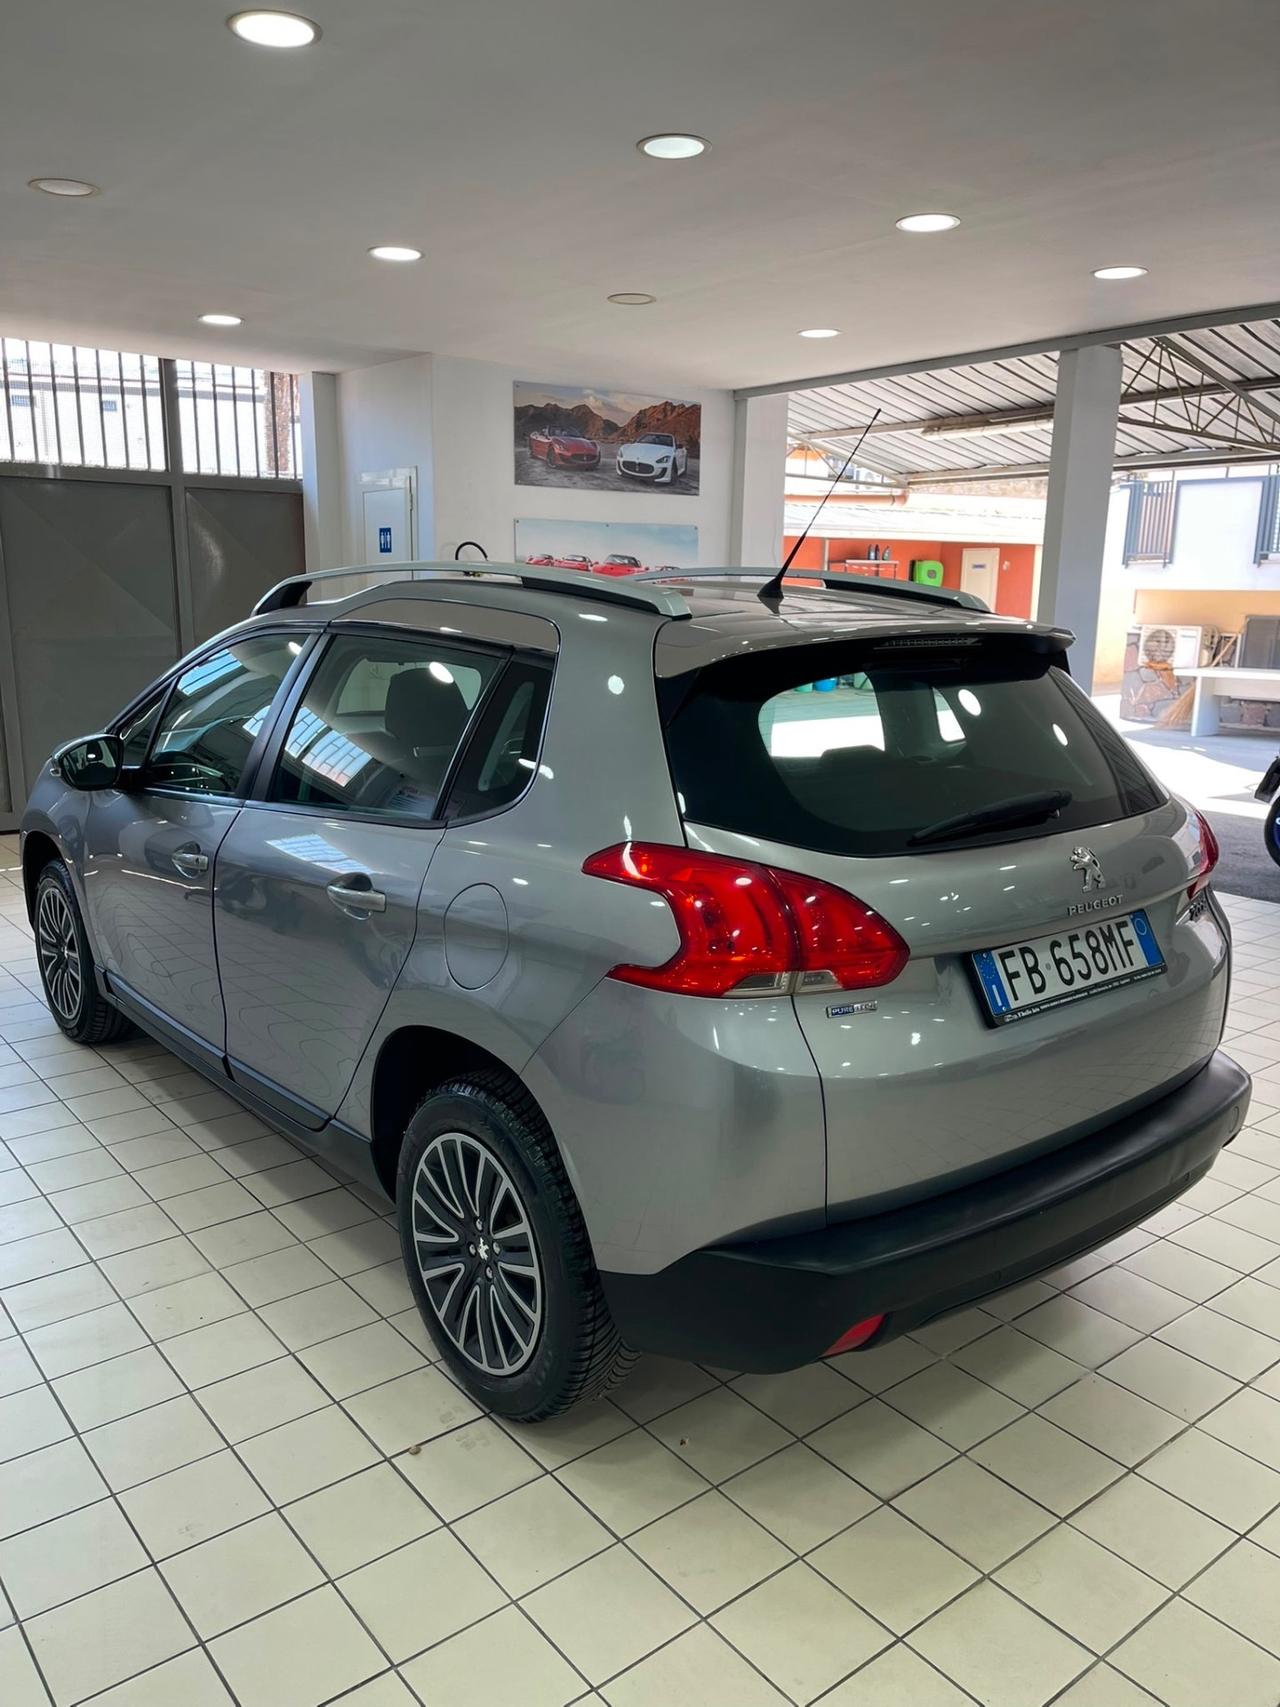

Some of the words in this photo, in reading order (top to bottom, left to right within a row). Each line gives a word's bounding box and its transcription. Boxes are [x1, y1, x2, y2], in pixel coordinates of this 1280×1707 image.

[1067, 894, 1123, 916] PEUGEOT
[998, 946, 1047, 1002] FB
[1049, 920, 1135, 987] 658MF
